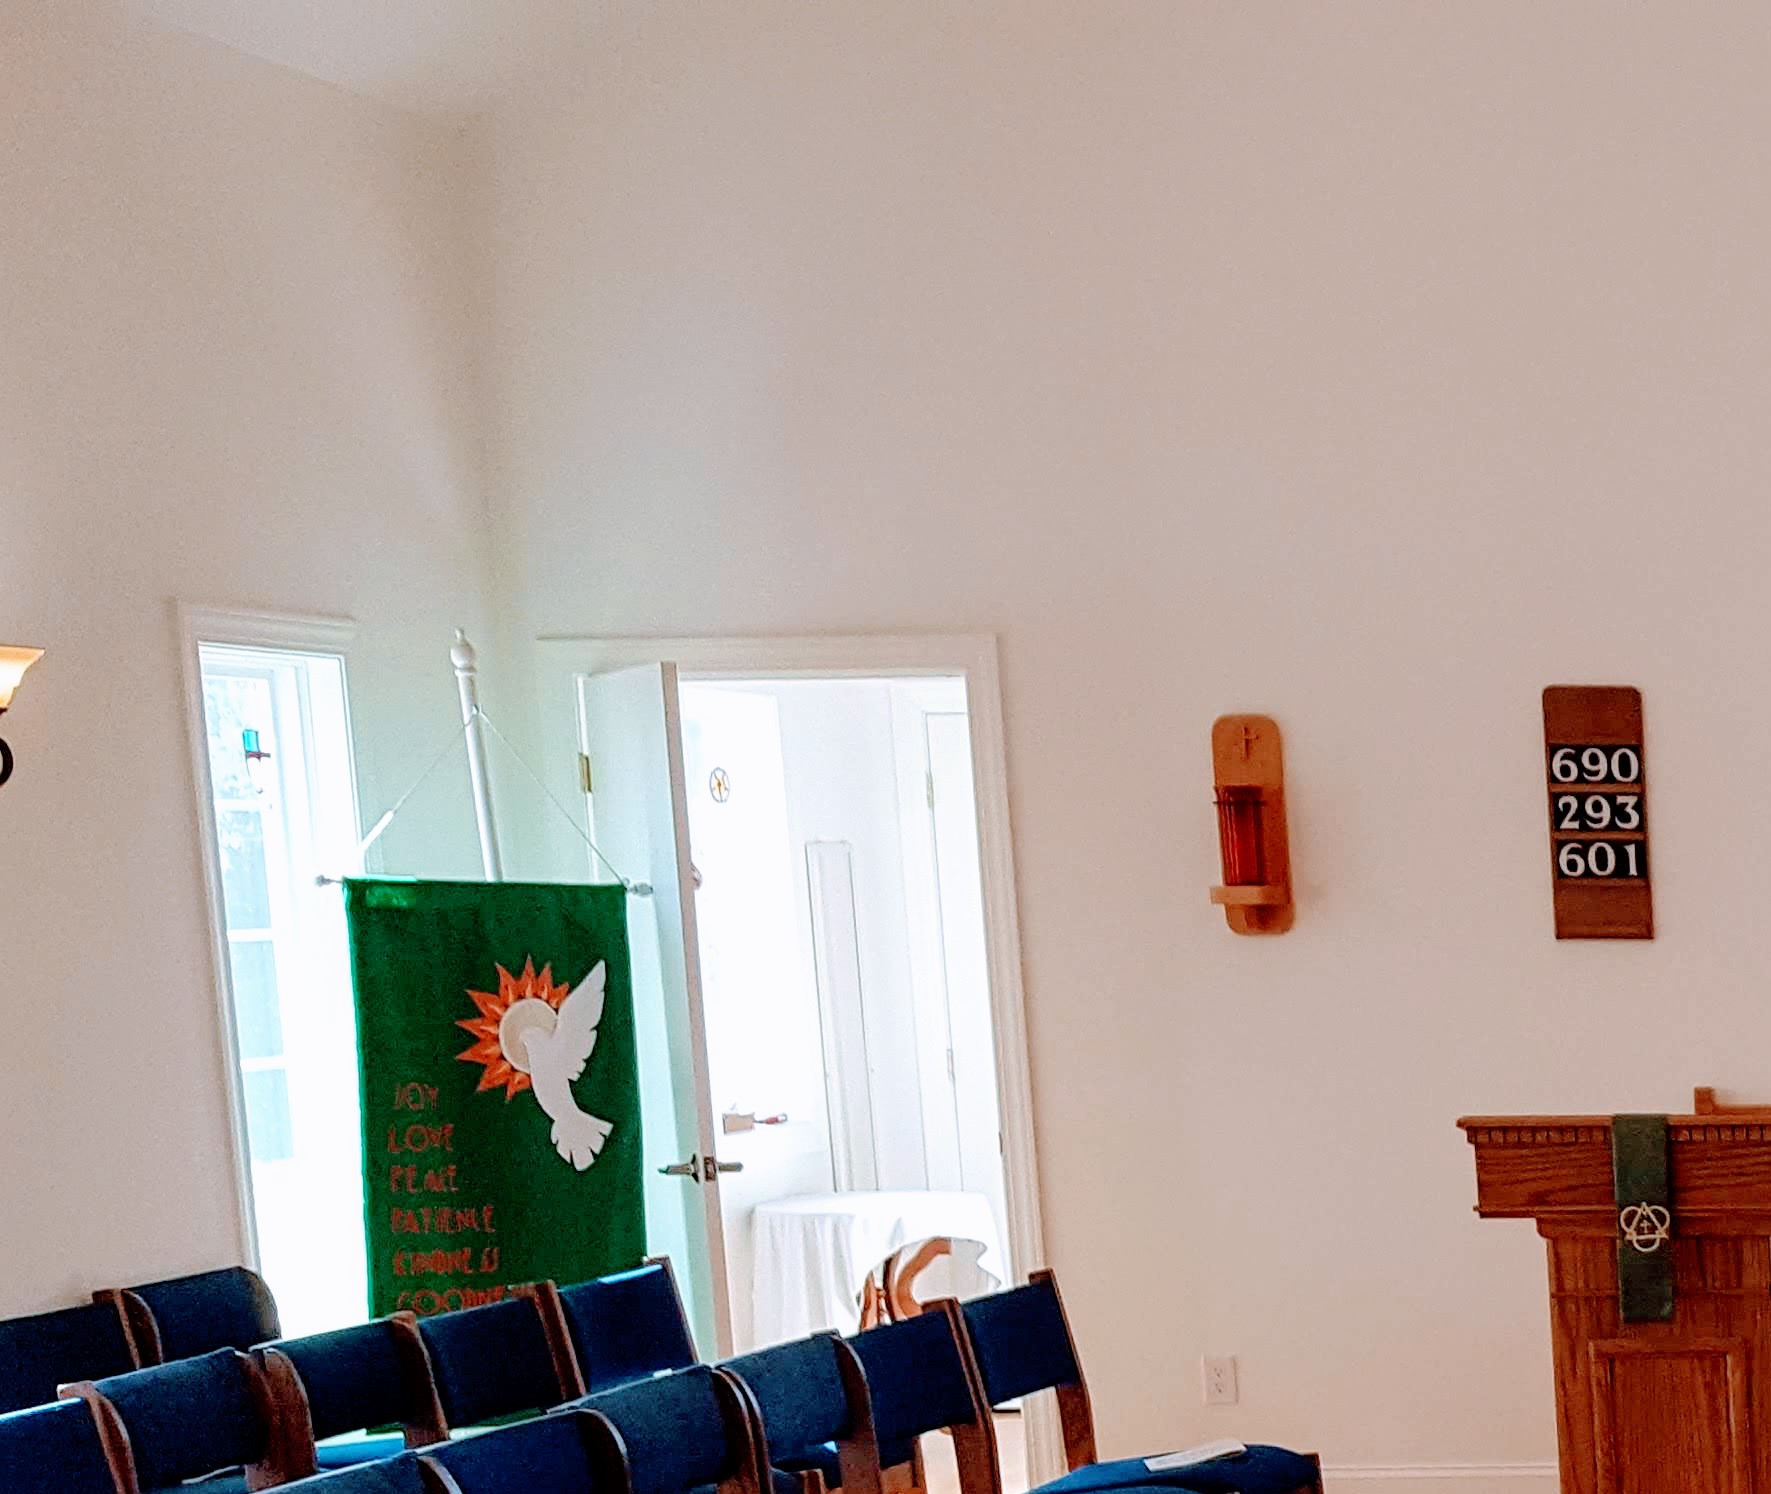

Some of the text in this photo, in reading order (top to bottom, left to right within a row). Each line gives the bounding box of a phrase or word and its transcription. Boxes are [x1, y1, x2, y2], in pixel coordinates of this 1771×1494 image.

[1551, 747, 1640, 783] 690
[1557, 795, 1641, 830] 293
[1558, 841, 1639, 877] 601
